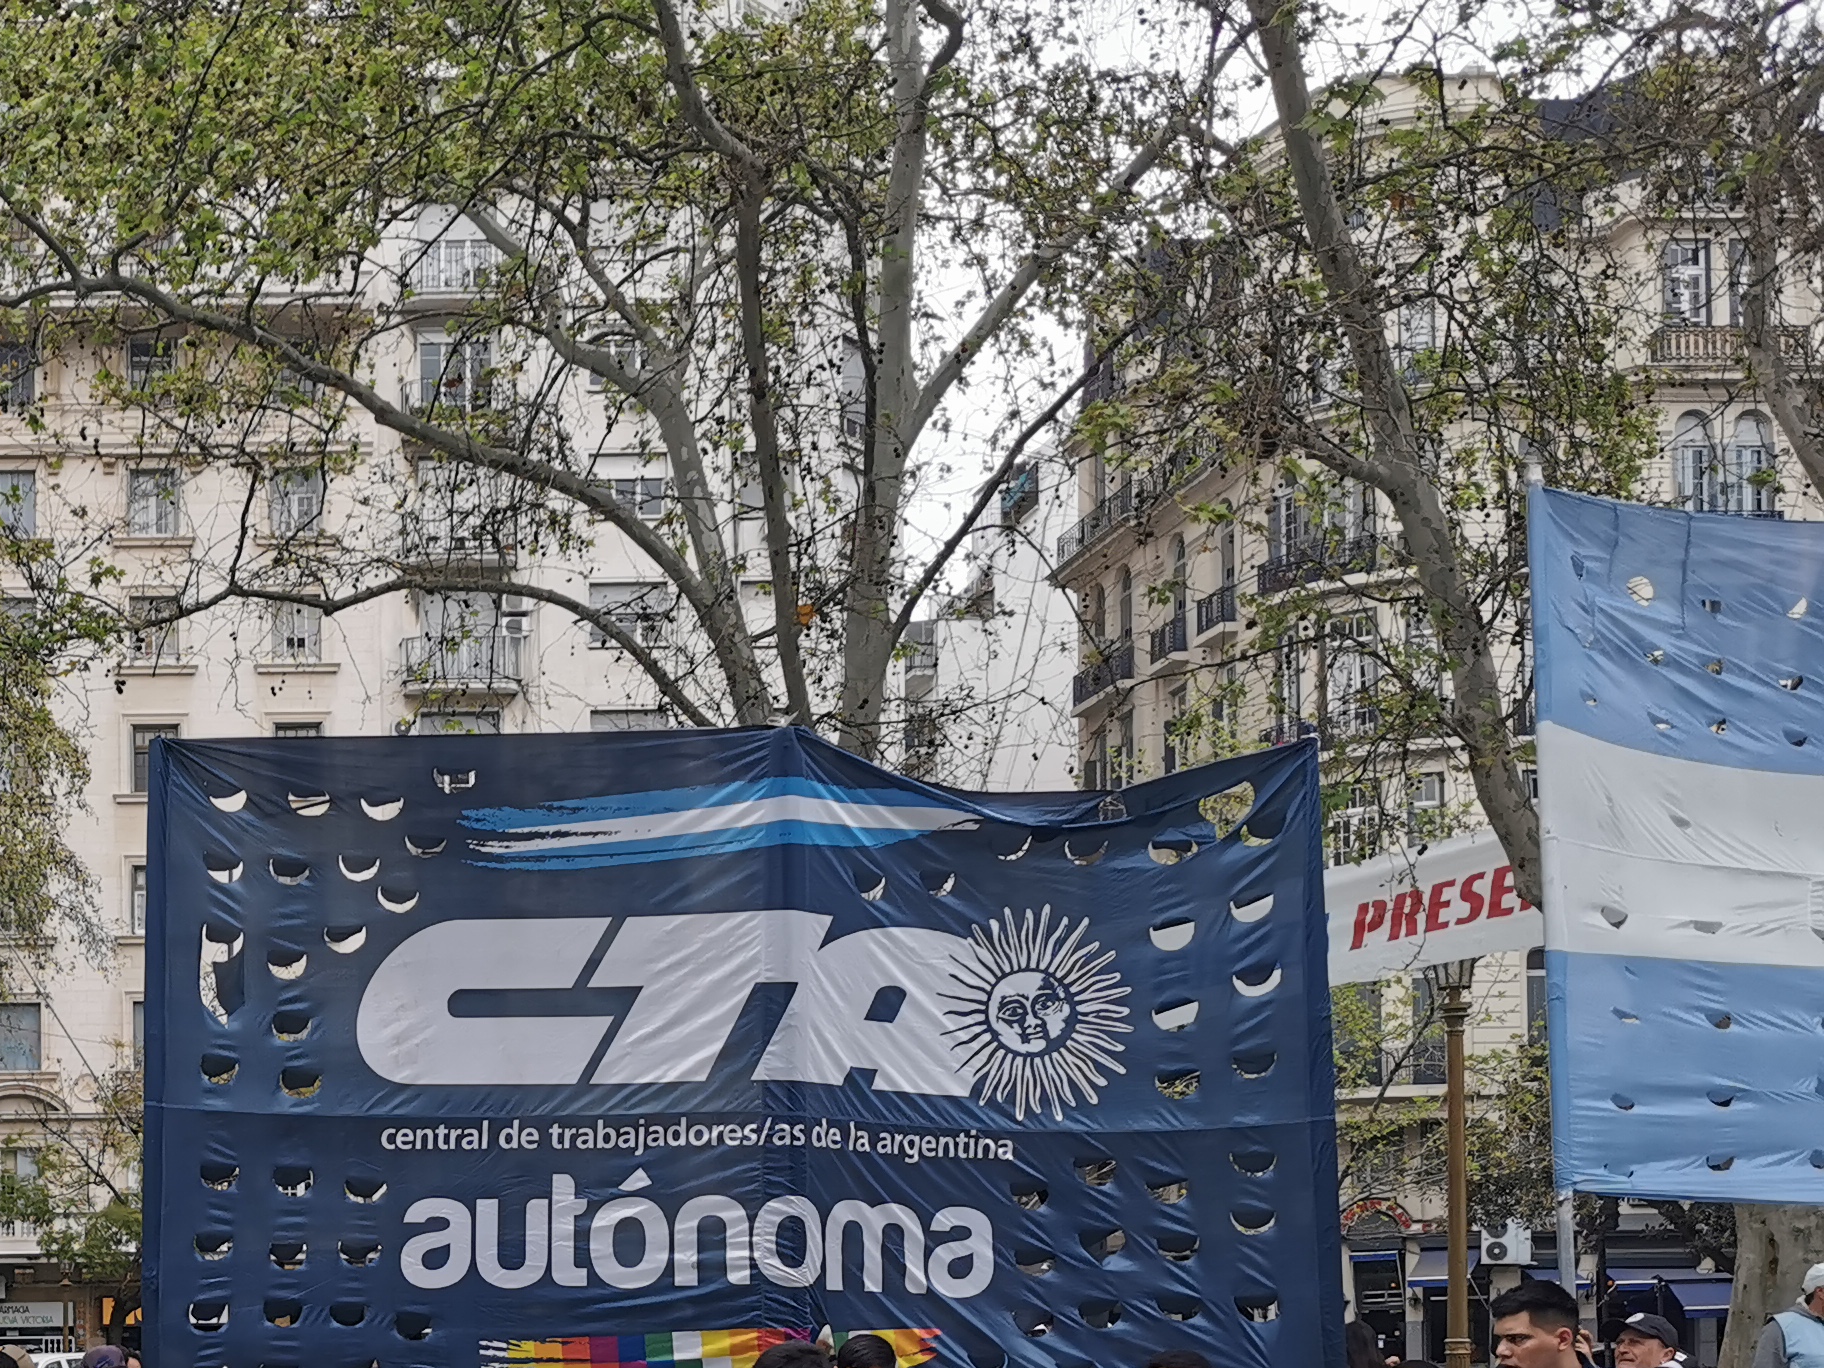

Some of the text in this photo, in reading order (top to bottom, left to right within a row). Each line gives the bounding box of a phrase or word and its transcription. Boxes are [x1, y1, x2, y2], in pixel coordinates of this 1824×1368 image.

[1349, 865, 1534, 951] PRESE
[356, 910, 976, 1097] CTA
[380, 1117, 1014, 1164] central de trabajadores/as de la argentina
[399, 1167, 995, 1299] autónoma
